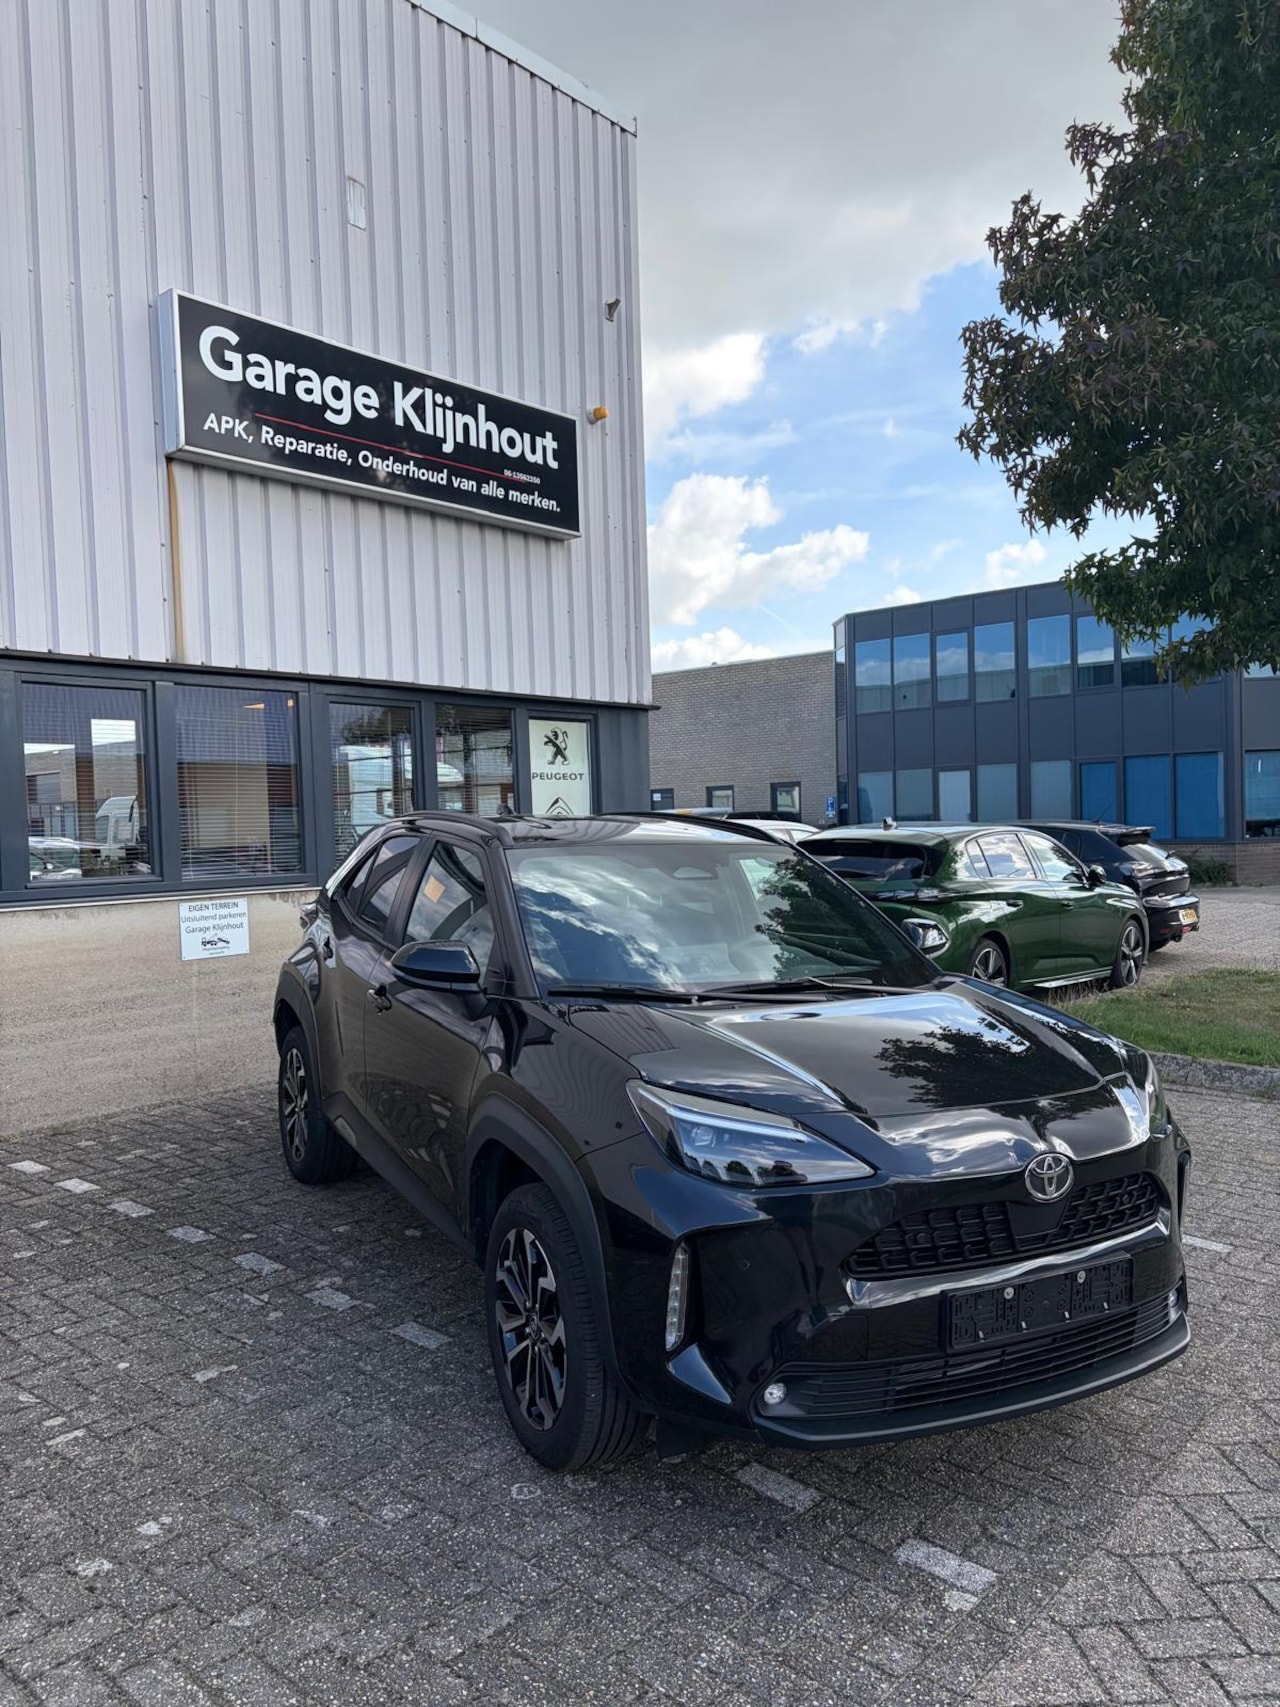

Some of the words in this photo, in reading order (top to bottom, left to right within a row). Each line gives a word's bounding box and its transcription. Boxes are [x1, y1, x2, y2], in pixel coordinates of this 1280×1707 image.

[199, 325, 380, 425] Garage
[393, 381, 559, 469] Klijnhout
[203, 412, 254, 444] APK,
[261, 425, 352, 466] Reparatie,
[358, 450, 448, 486] Onderhoud
[451, 474, 477, 493] van
[481, 480, 505, 499] alle
[508, 489, 561, 513] merken.
[532, 772, 584, 781] PEUGEOT
[188, 903, 210, 912] EIGEN
[211, 901, 239, 910] TERREIN
[181, 913, 217, 923] Uitsluitend
[218, 911, 247, 921] parkeren
[185, 925, 211, 934] Garage
[212, 922, 244, 933] Klijnhout
